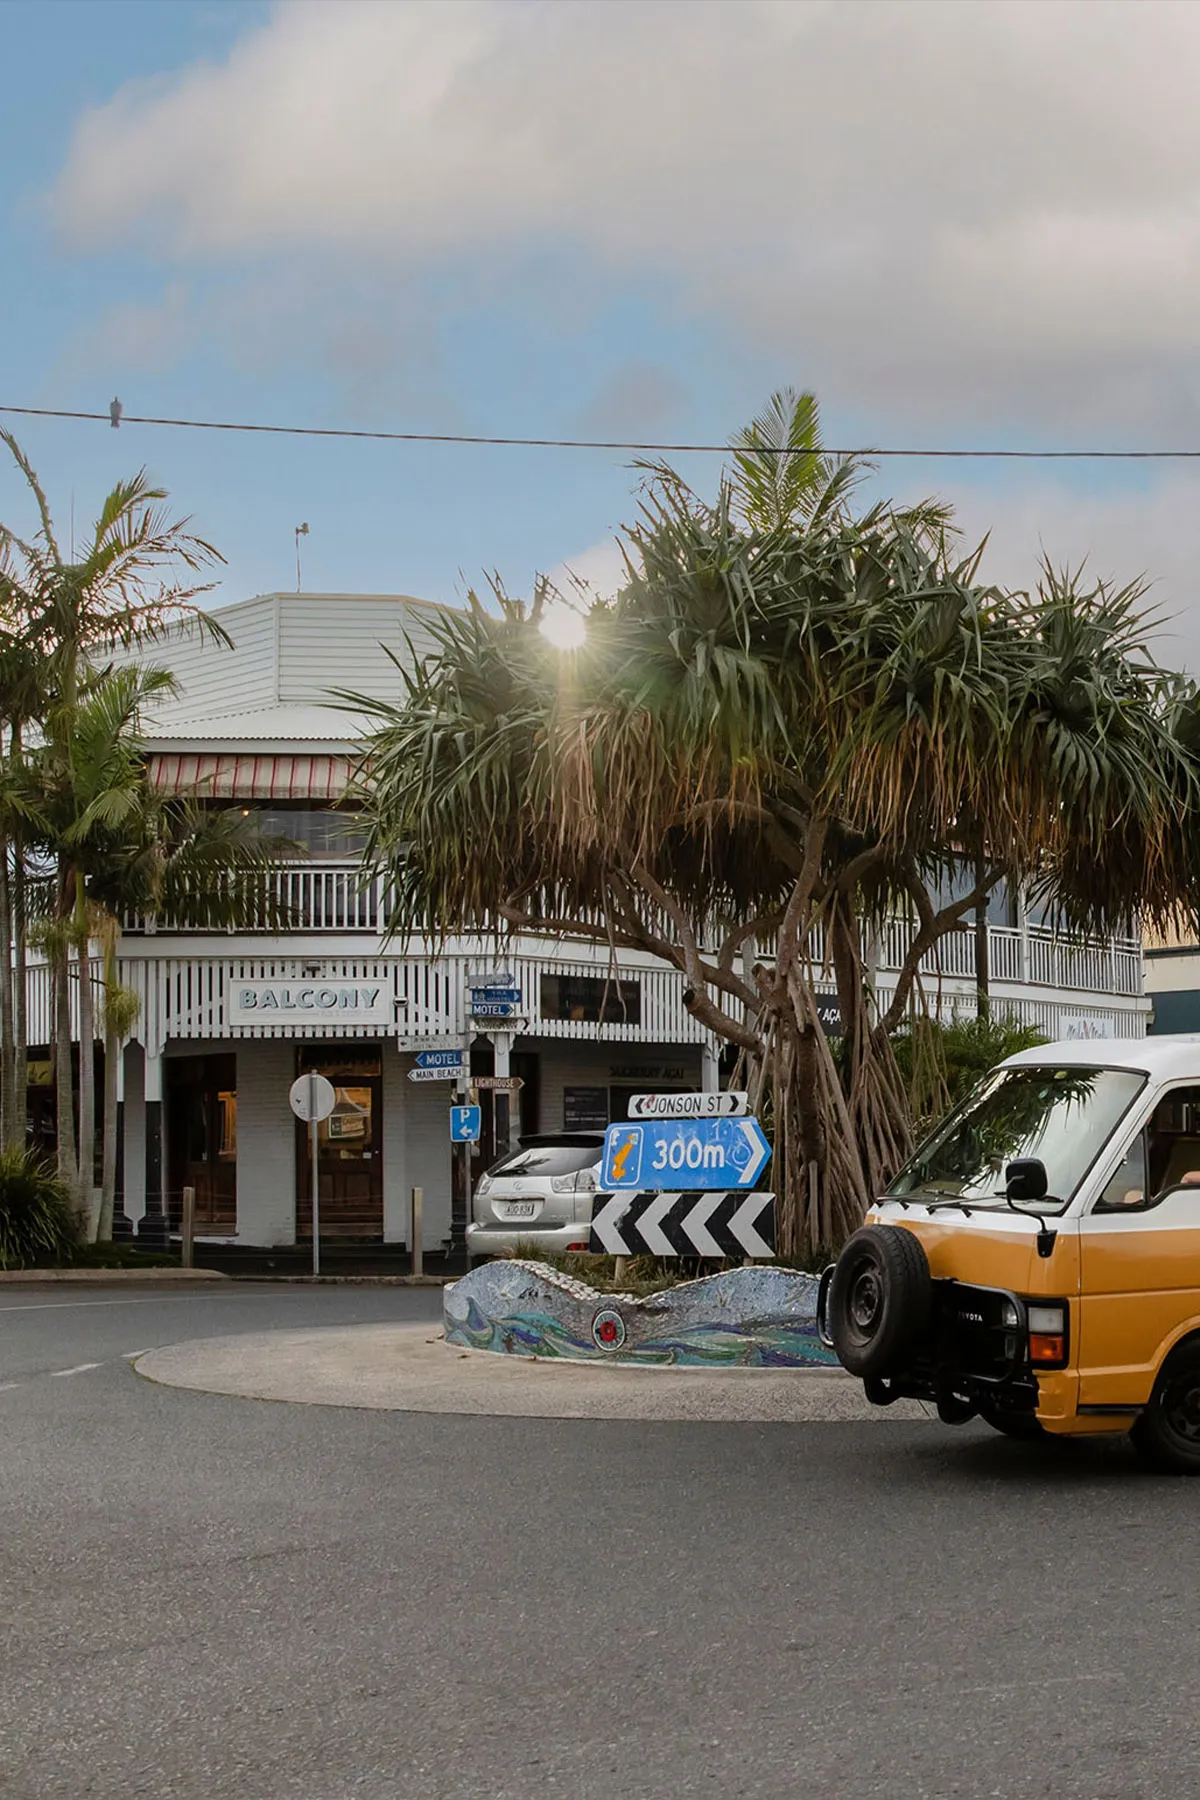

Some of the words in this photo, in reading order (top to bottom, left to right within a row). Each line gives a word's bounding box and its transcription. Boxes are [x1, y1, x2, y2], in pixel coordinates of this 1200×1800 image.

[239, 988, 380, 1009] BALCONY
[473, 1005, 505, 1015] MOTEL
[822, 1008, 841, 1025] AÇA
[426, 1053, 460, 1065] MOTEL
[416, 1071, 434, 1079] MAIN
[437, 1069, 461, 1078] BEACH
[475, 1078, 514, 1088] LIGHTHOUSE
[650, 1096, 702, 1113] JONSON
[707, 1095, 723, 1112] ST
[460, 1109, 470, 1123] P
[652, 1138, 725, 1170] 300m
